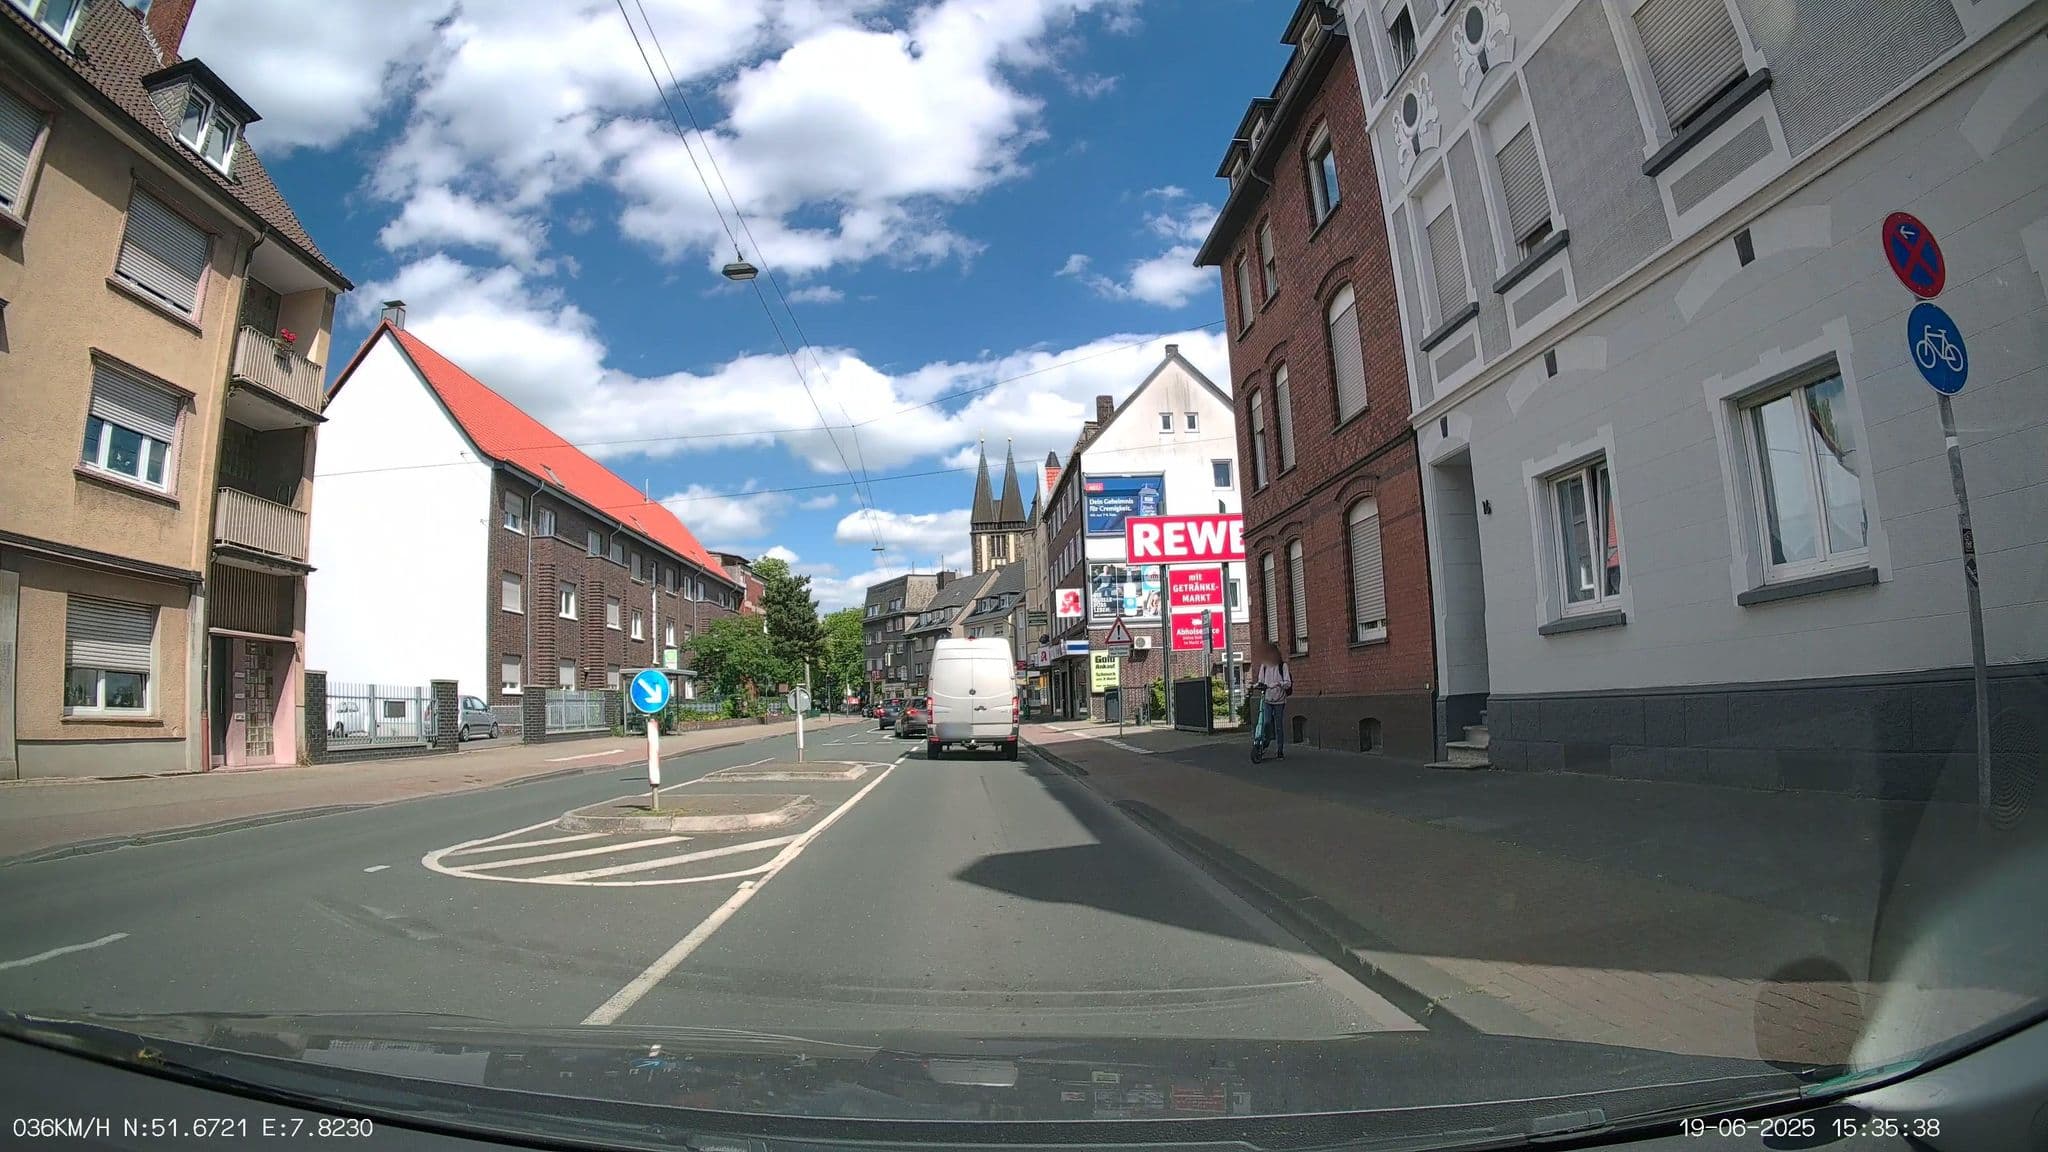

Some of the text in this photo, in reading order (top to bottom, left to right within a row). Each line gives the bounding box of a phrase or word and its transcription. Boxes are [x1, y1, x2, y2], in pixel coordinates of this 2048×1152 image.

[1133, 521, 1245, 557] REWE
[1188, 572, 1203, 582] mit
[1173, 581, 1219, 593] GETRÄNKE-
[1182, 594, 1211, 603] MARKT
